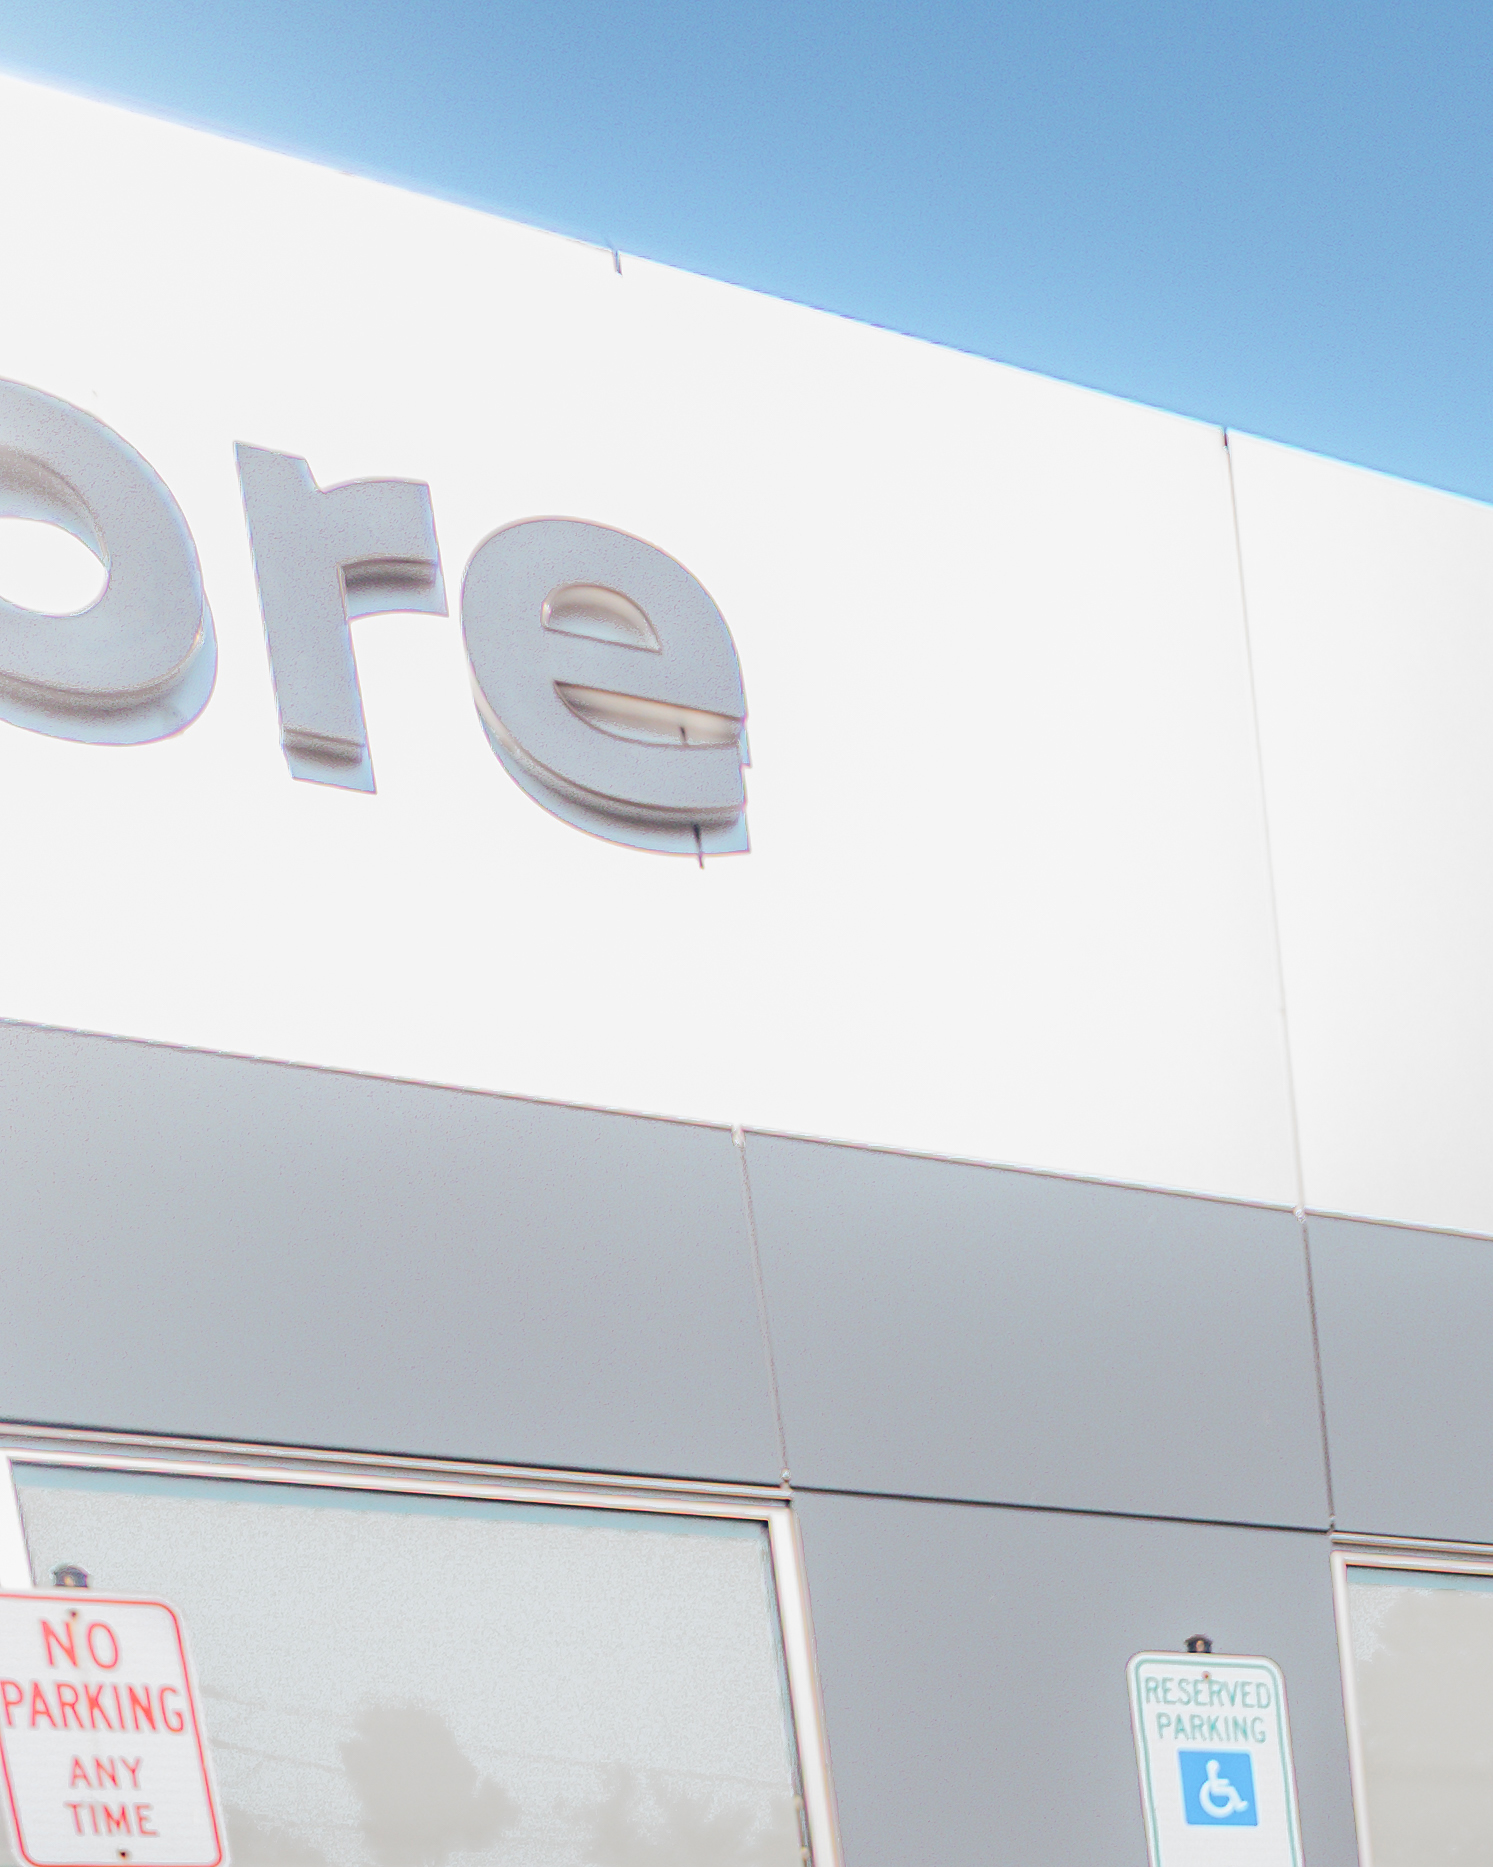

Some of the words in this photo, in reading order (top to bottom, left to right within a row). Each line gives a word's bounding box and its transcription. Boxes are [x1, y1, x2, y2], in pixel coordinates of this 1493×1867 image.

[41, 1620, 120, 1669] NO
[1, 1680, 185, 1733] PARKING
[1145, 1676, 1272, 1710] RESERVED
[1156, 1712, 1266, 1744] PARKING
[69, 1757, 143, 1789] ANY
[67, 1802, 158, 1837] TIME
